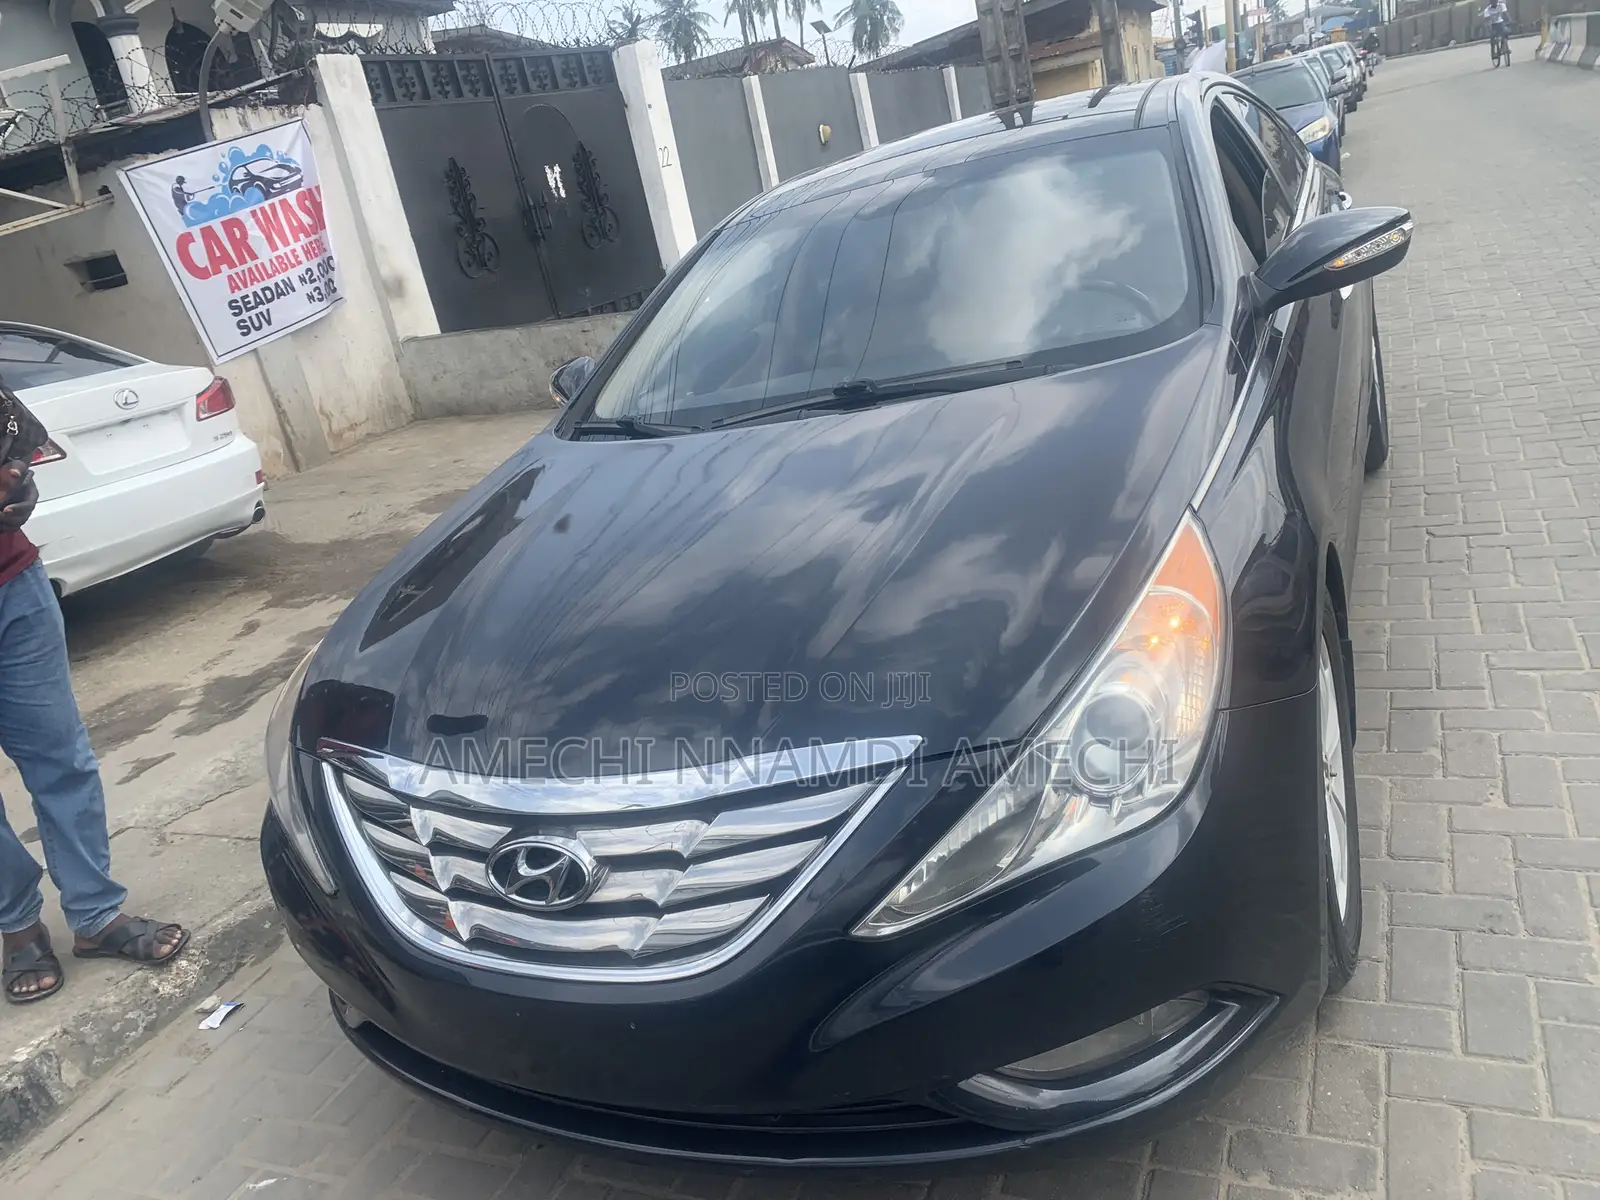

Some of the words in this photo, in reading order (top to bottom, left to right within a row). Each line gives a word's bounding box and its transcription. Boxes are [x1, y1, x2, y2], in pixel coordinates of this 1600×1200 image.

[658, 146, 673, 168] 22
[176, 217, 259, 280] CAR
[226, 247, 303, 294] AVAILABLE
[228, 277, 296, 317] SEADAN
[236, 308, 273, 337] SUV
